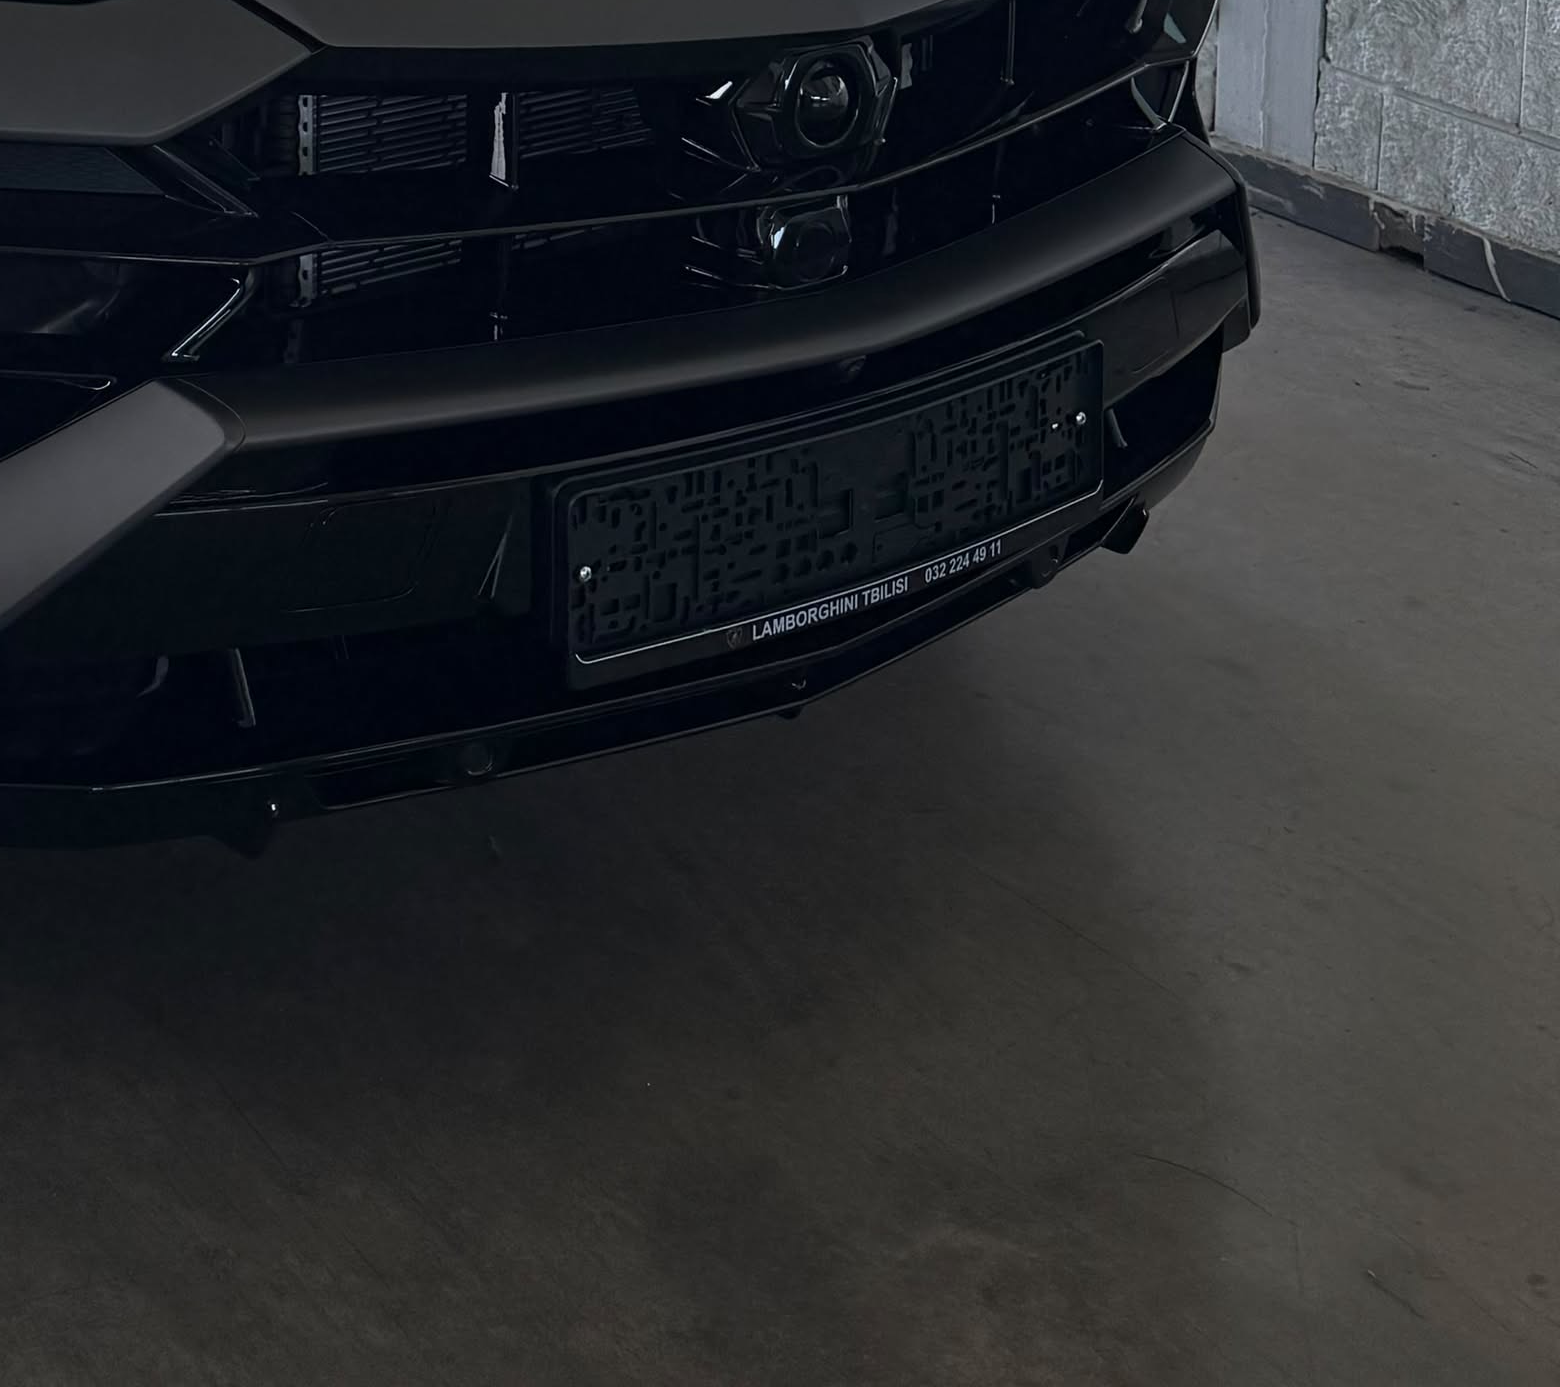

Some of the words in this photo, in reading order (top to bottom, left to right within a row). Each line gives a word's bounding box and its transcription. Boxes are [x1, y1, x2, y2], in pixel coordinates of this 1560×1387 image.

[751, 593, 859, 642] LAMBORGHINI
[862, 576, 909, 608] TBILISI
[924, 560, 947, 583] 032
[948, 553, 971, 574] 224
[972, 545, 987, 565] 49
[989, 539, 1002, 559] 11
